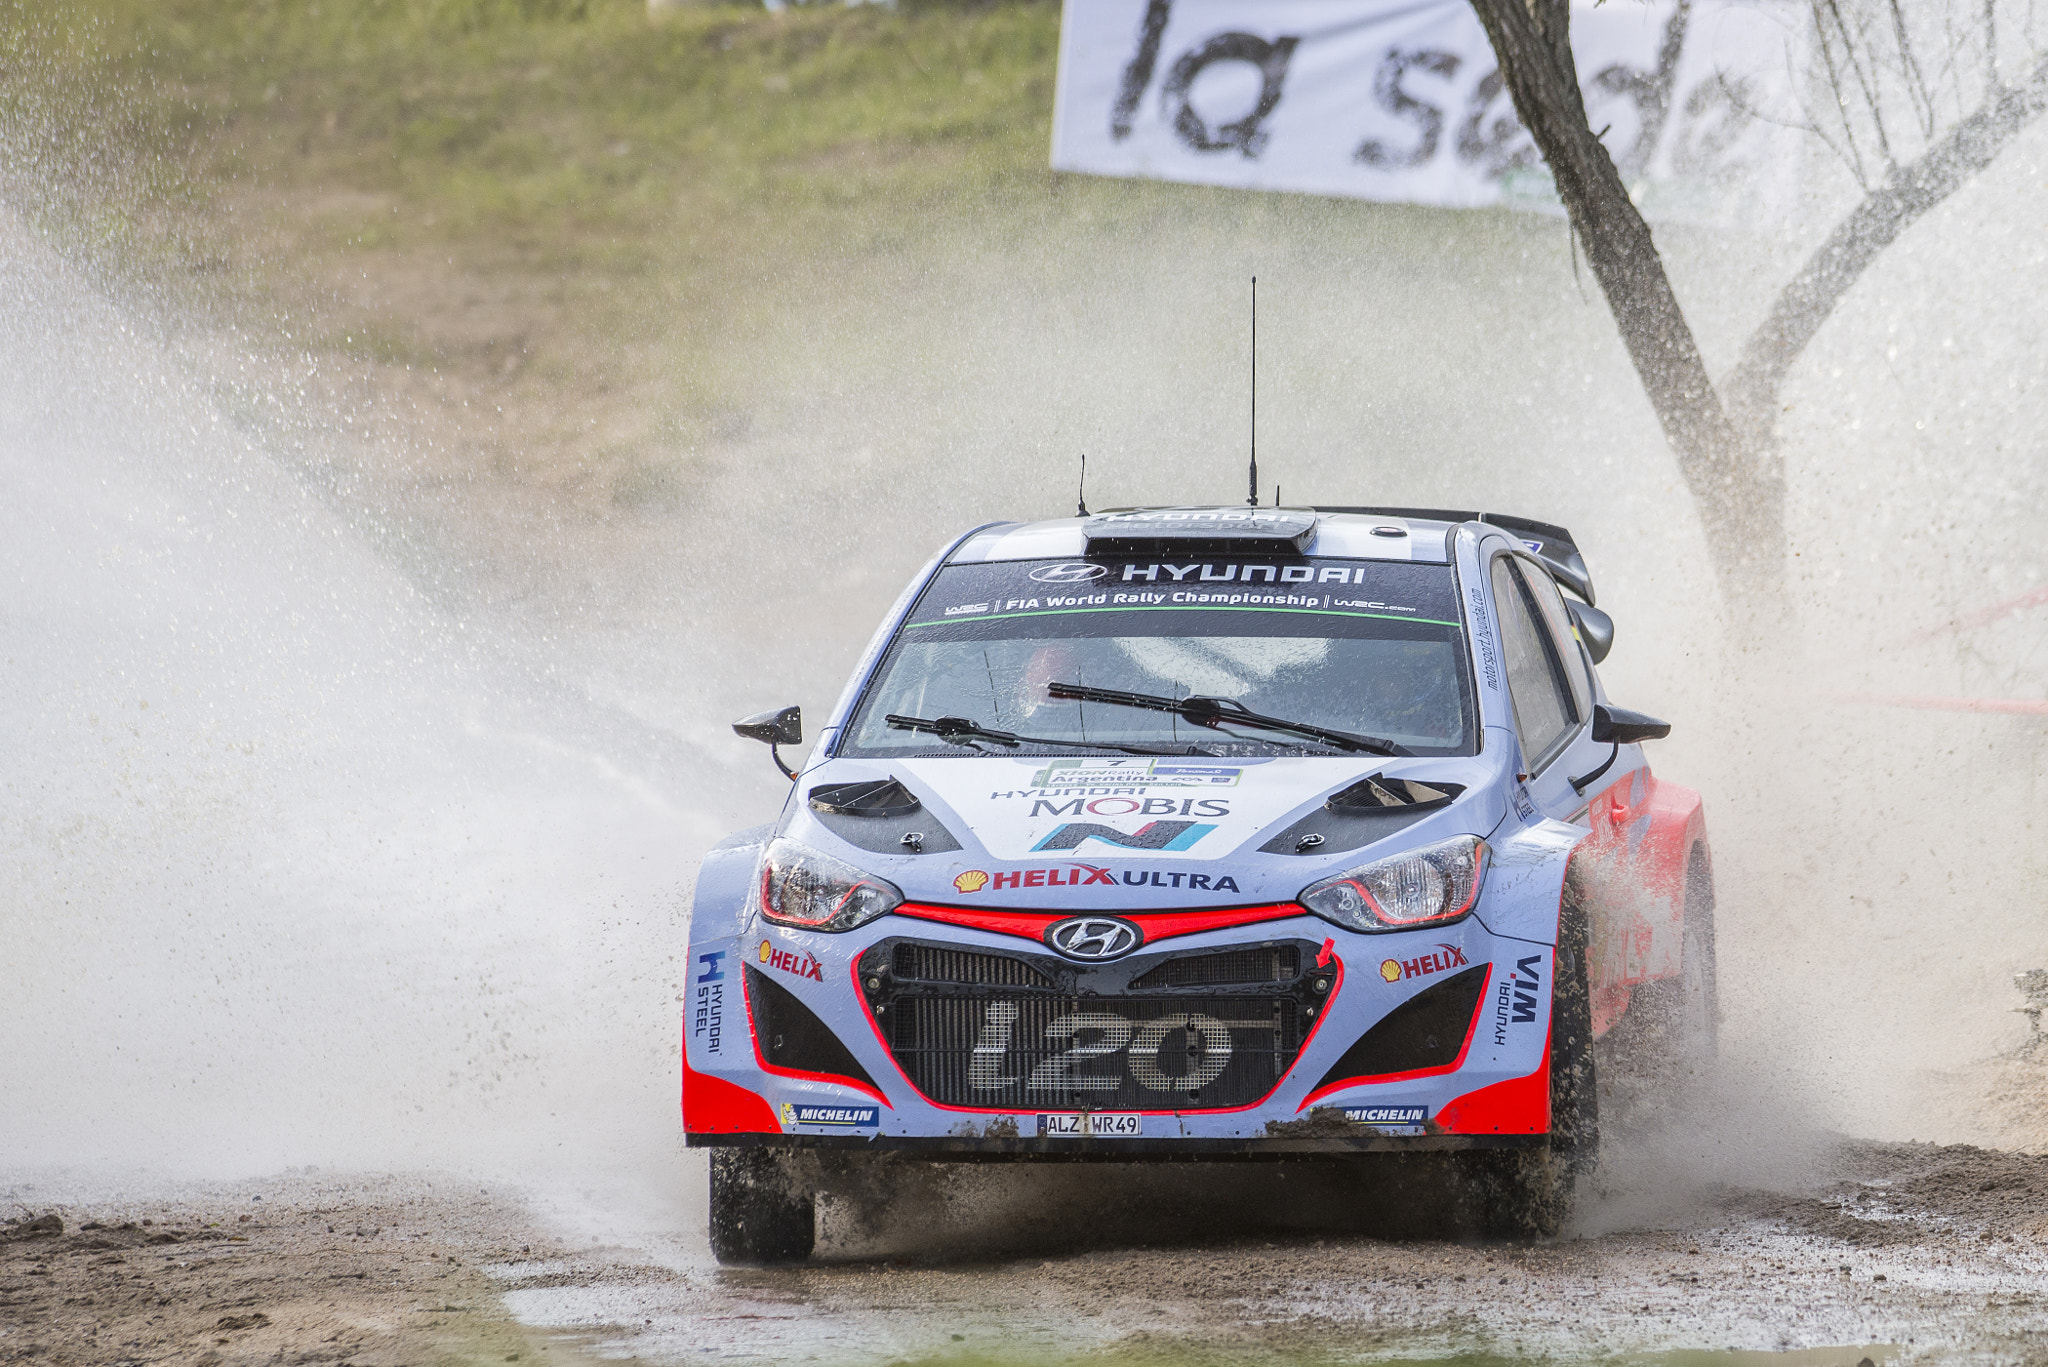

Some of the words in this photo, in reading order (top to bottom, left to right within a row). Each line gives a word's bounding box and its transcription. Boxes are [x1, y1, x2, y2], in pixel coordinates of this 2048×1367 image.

[1110, 0, 1301, 160] la
[1106, 512, 1289, 522] HYUNDAI
[1121, 563, 1366, 584] HYUNDAI
[1005, 598, 1040, 611] FIA
[1046, 593, 1107, 607] World
[1112, 592, 1166, 605] Rally
[1172, 591, 1320, 608] Championship
[1471, 587, 1499, 692] motorsport.hyundai.com
[1052, 774, 1158, 784] Argentina
[990, 787, 1147, 800] HYUNDAI
[1028, 796, 1231, 818] MOBIS
[769, 947, 824, 983] HELIX
[1402, 943, 1470, 980] HELIX
[695, 986, 709, 1038] STEEL
[708, 983, 723, 1054] HYUNDAI
[1494, 981, 1511, 1046] HYUNDAI
[966, 1000, 1233, 1092] i20
[799, 1107, 874, 1122] MICHELIN
[1047, 1116, 1080, 1133] ALZ
[1345, 1108, 1424, 1121] MICHELIN
